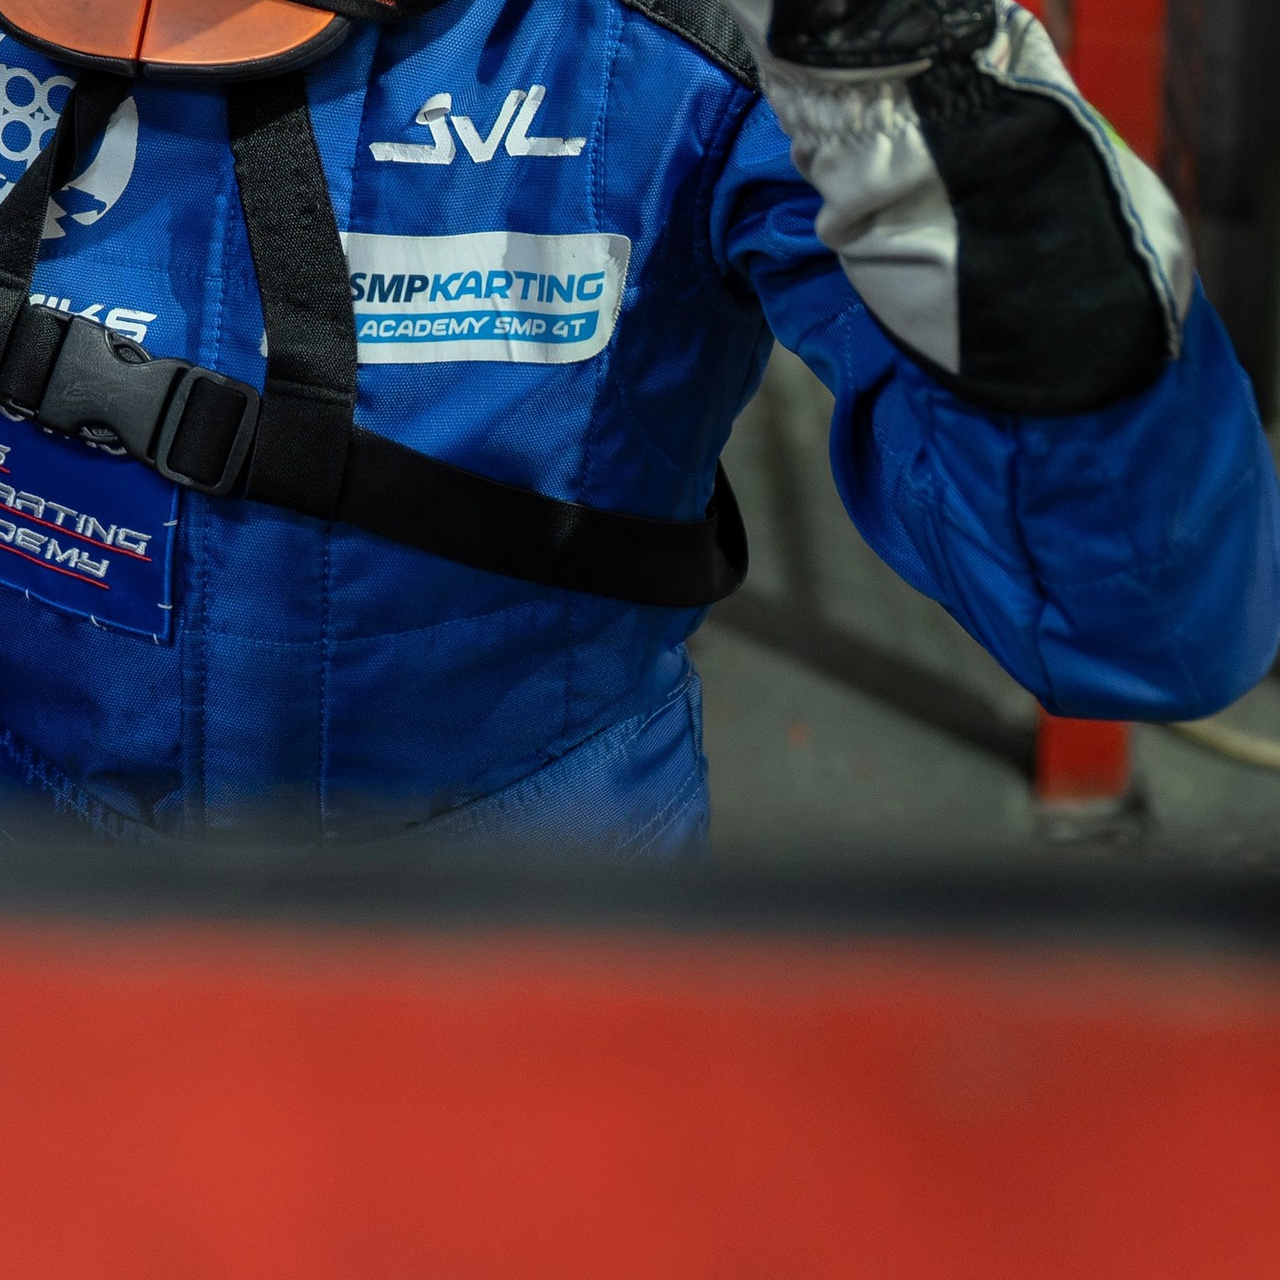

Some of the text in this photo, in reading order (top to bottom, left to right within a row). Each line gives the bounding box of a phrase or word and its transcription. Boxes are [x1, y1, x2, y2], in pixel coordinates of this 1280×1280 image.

[350, 269, 606, 304] SMPKARTING
[359, 316, 491, 338] ACADEMY
[493, 317, 547, 336] SMP
